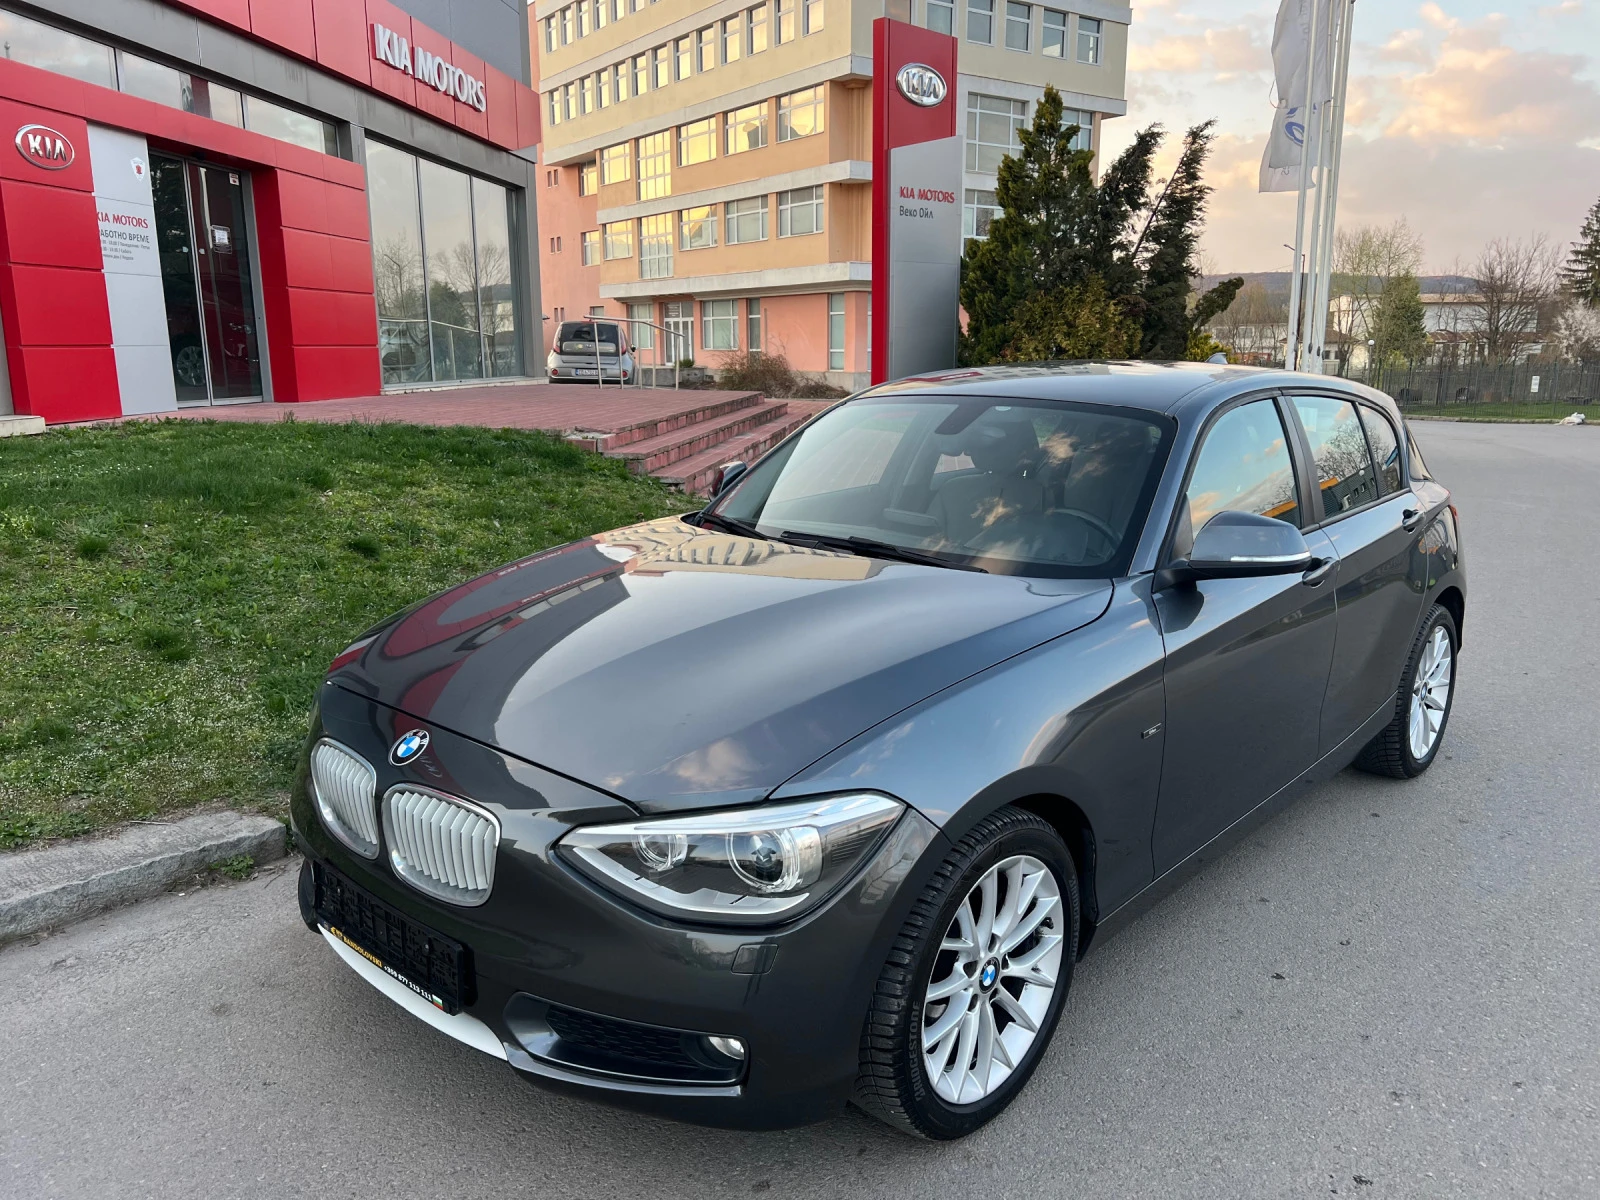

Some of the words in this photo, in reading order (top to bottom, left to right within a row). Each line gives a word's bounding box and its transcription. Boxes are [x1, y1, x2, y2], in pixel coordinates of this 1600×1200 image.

[374, 23, 413, 75] KIA
[414, 47, 486, 113] MOTORS
[905, 70, 941, 99] KIA
[27, 133, 67, 161] KIA
[899, 186, 915, 199] KIA
[918, 188, 955, 204] MOTORS
[112, 213, 149, 229] MOTORS
[899, 205, 918, 218] Веко
[919, 207, 934, 219] Ойл
[100, 229, 128, 241] АБОТНО
[128, 232, 150, 244] ВРЕМЕ
[908, 1000, 926, 1102] BRIDGESTONE
